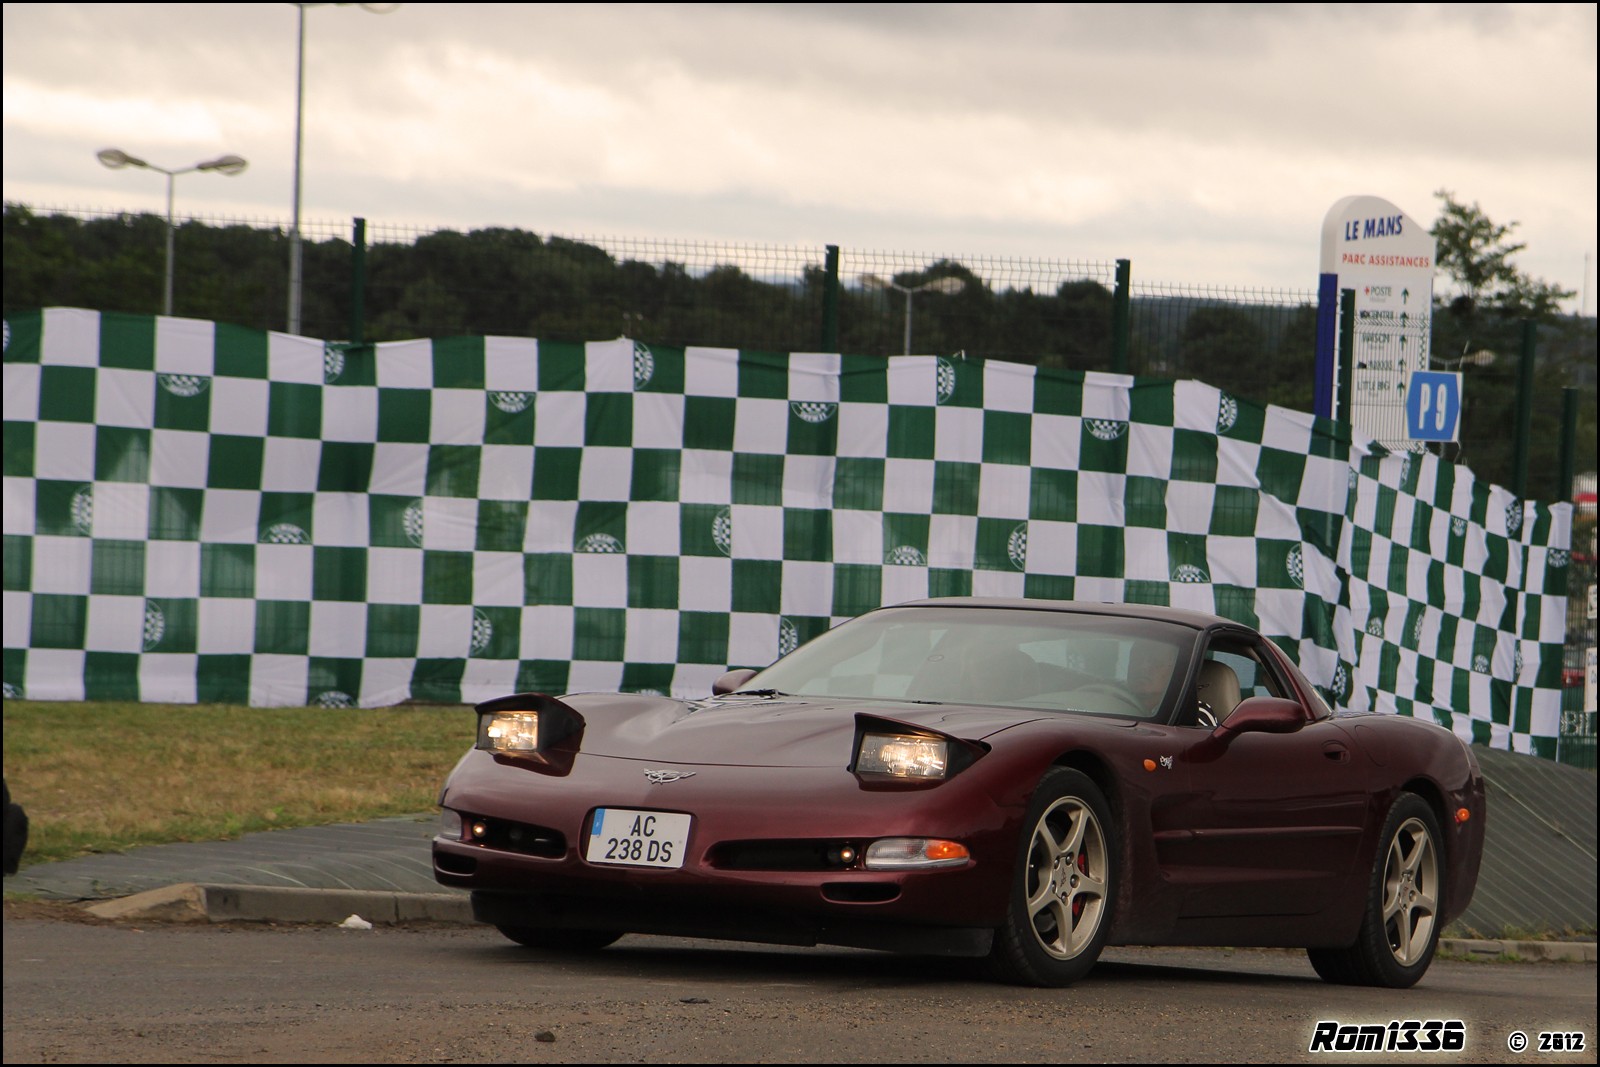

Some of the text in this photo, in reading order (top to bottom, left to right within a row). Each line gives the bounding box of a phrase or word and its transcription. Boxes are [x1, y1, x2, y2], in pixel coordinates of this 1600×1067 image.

[1345, 215, 1403, 241] LE MANS
[1342, 253, 1430, 268] PARC ASSISTANCES
[1370, 286, 1392, 297] POSTE
[630, 814, 656, 837] AC
[605, 838, 673, 863] 238 DS
